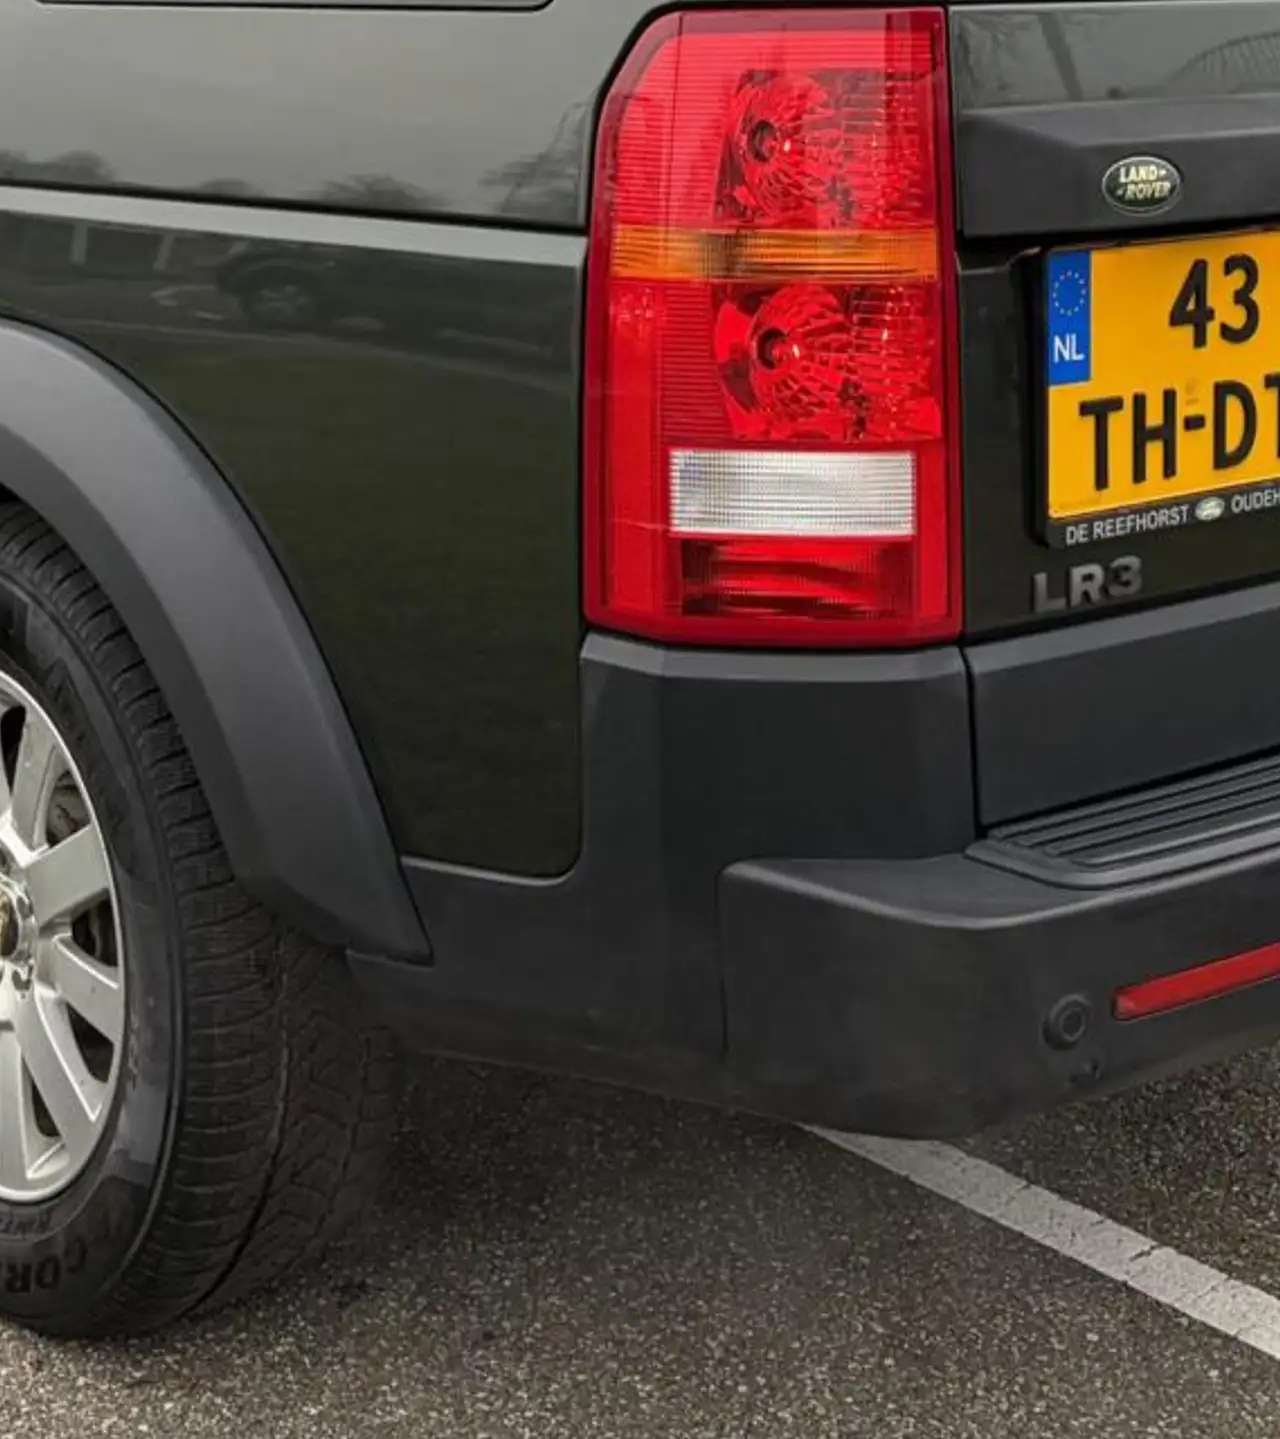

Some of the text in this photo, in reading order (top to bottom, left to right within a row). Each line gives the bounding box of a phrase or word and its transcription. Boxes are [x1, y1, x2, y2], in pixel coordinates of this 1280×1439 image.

[1169, 253, 1260, 349] 43
[1052, 333, 1085, 363] NL
[1065, 523, 1089, 546] DE
[1092, 505, 1190, 540] REEFHORST
[1033, 554, 1142, 615] LR3
